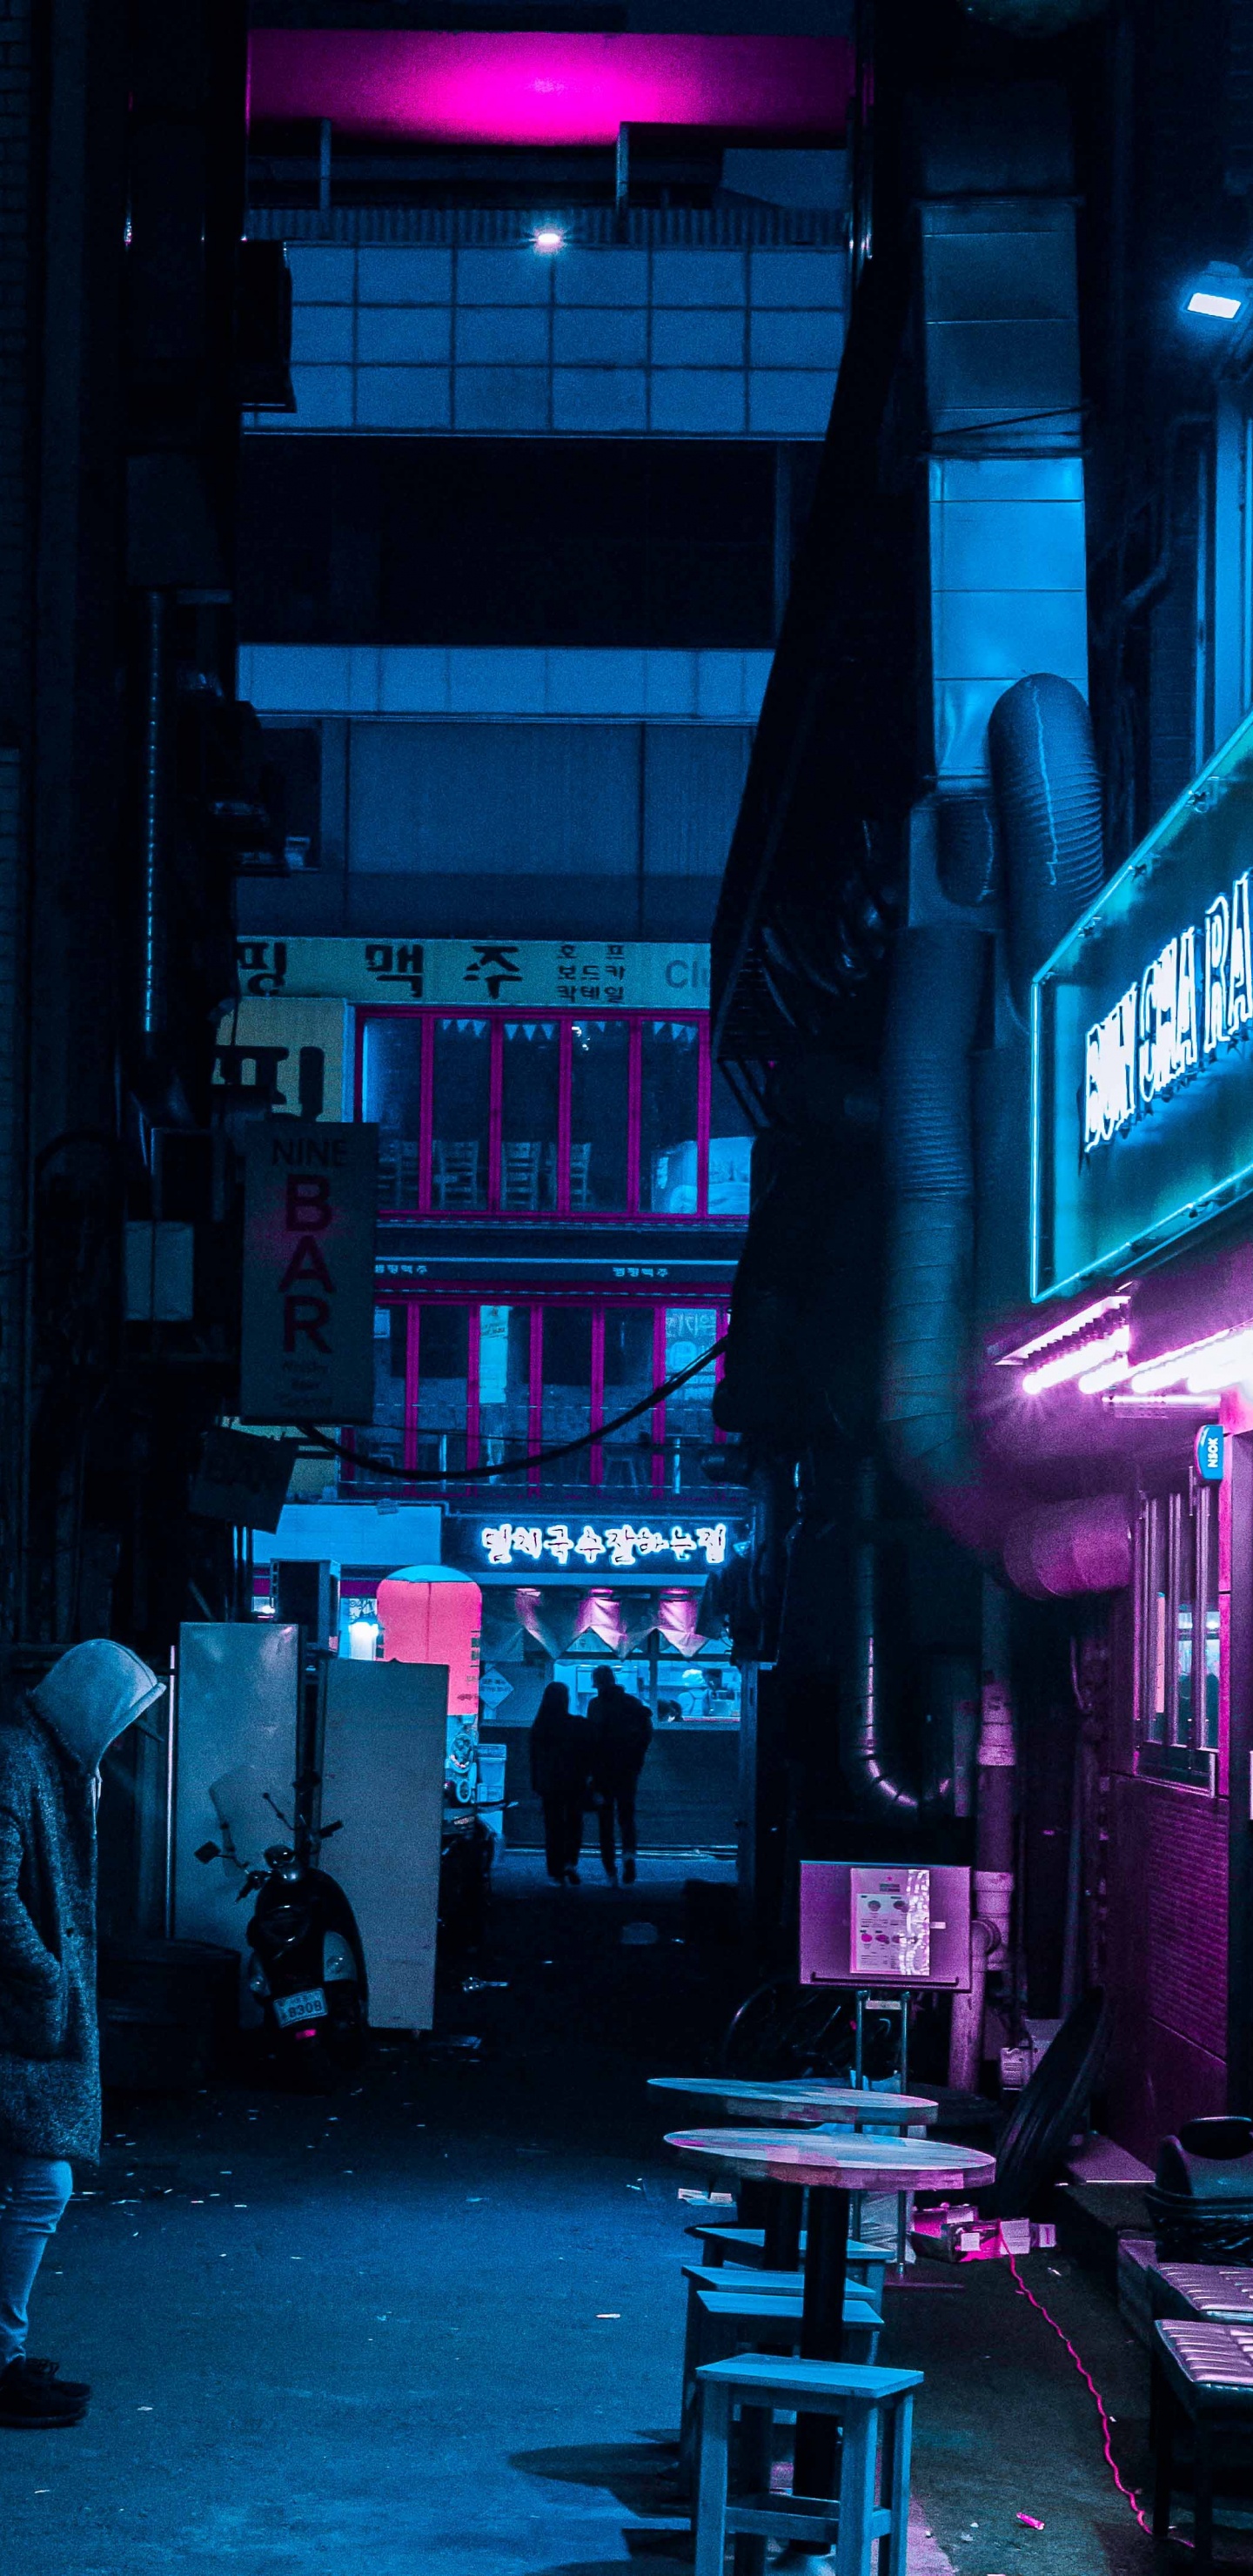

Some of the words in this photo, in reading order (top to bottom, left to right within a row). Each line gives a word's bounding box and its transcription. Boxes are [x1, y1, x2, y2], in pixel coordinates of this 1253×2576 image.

[557, 943, 626, 960] 호프
[557, 964, 626, 981] 보드카
[556, 985, 625, 1003] 칵테일
[1138, 925, 1199, 1104] CHA
[271, 1137, 348, 1167] NINE
[278, 1174, 335, 1353] BAR
